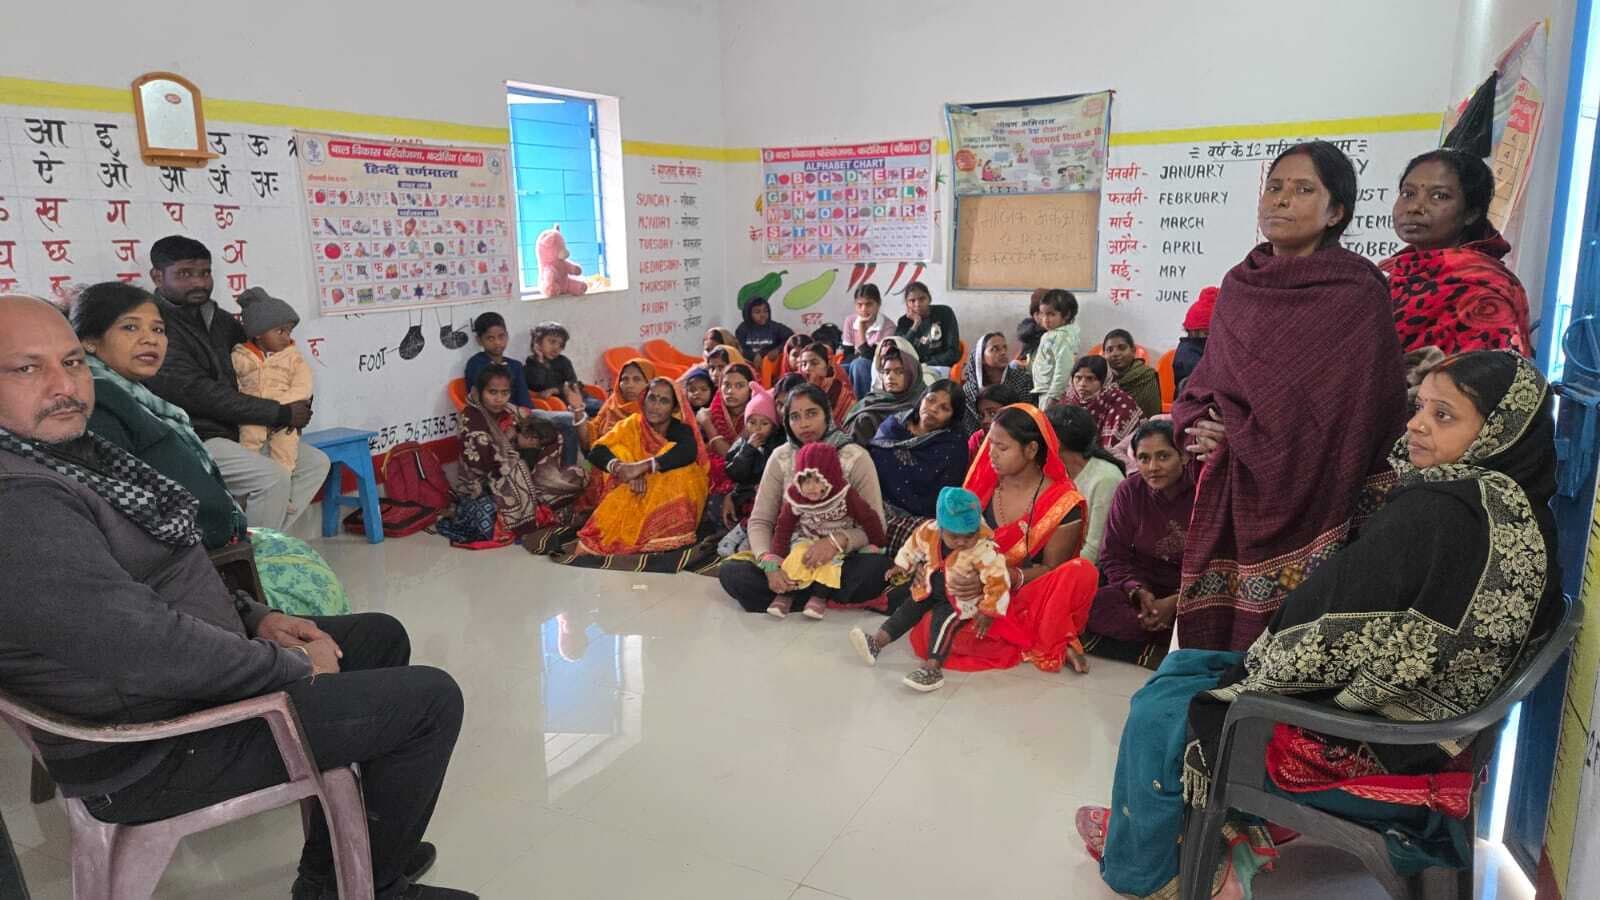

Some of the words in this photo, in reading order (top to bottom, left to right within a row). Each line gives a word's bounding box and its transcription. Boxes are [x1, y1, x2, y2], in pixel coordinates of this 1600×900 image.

[25, 118, 67, 148] आ
[208, 132, 231, 155] उ
[248, 135, 269, 157] ऊ
[331, 143, 350, 154] बाल
[352, 142, 381, 158] विकास
[1208, 141, 1230, 158] वर्ष
[1231, 141, 1244, 157] के
[1246, 143, 1261, 157] 12
[364, 162, 399, 176] हिन्दी
[405, 165, 459, 179] वर्णमाला
[805, 160, 851, 171] ALPHABET
[853, 158, 885, 169] CHART
[1160, 164, 1224, 179] JANUARY
[33, 152, 64, 184] ऐ
[251, 171, 279, 197] अः
[636, 192, 671, 207] SUNDAY
[1159, 191, 1228, 205] FEBRUARY
[107, 200, 131, 227] ग
[1109, 212, 1134, 228] मार्च
[639, 216, 671, 230] MONDAY
[1160, 216, 1205, 229] MARCH
[639, 238, 673, 249] TUESDAY
[1162, 240, 1204, 255] APRIL
[1345, 241, 1399, 256] TOBER
[112, 240, 141, 265] ज
[1110, 260, 1131, 280] मई
[1160, 265, 1186, 277] MAY
[640, 280, 677, 292] THURSDAY
[1156, 290, 1189, 303] JUNE
[641, 302, 668, 313] FRIDAY
[640, 321, 678, 337] SATURDAY
[358, 347, 387, 372] FOOT
